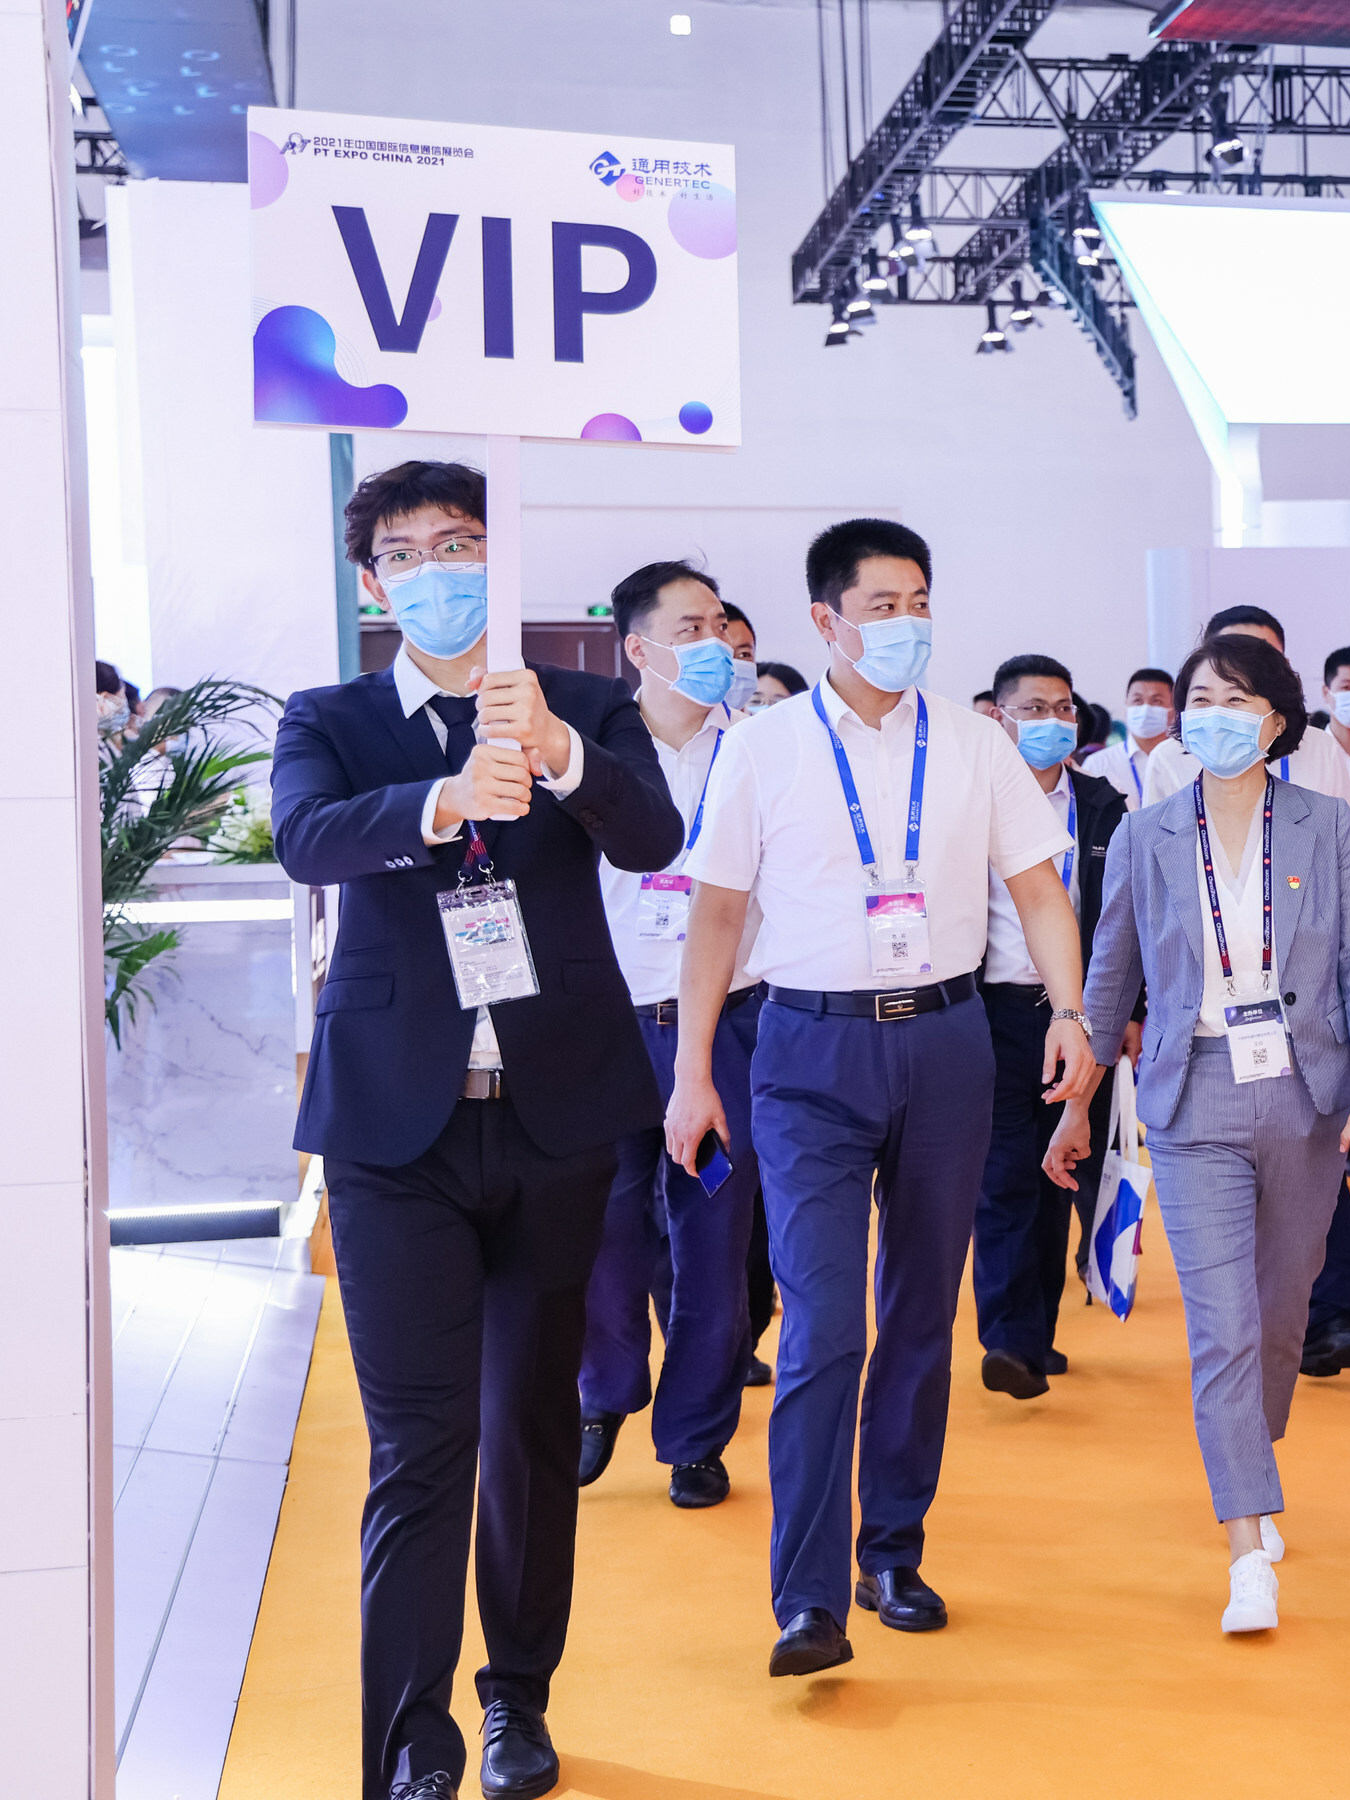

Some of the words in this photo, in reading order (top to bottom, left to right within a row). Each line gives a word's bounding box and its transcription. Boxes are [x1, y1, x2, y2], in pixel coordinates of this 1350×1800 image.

[314, 148, 328, 157] PT
[334, 150, 368, 160] EXPO
[373, 152, 412, 164] CHINA
[417, 156, 445, 166] 2021
[632, 158, 713, 177] 通用技术
[634, 175, 711, 190] GENERTEC
[331, 204, 658, 364] VIP
